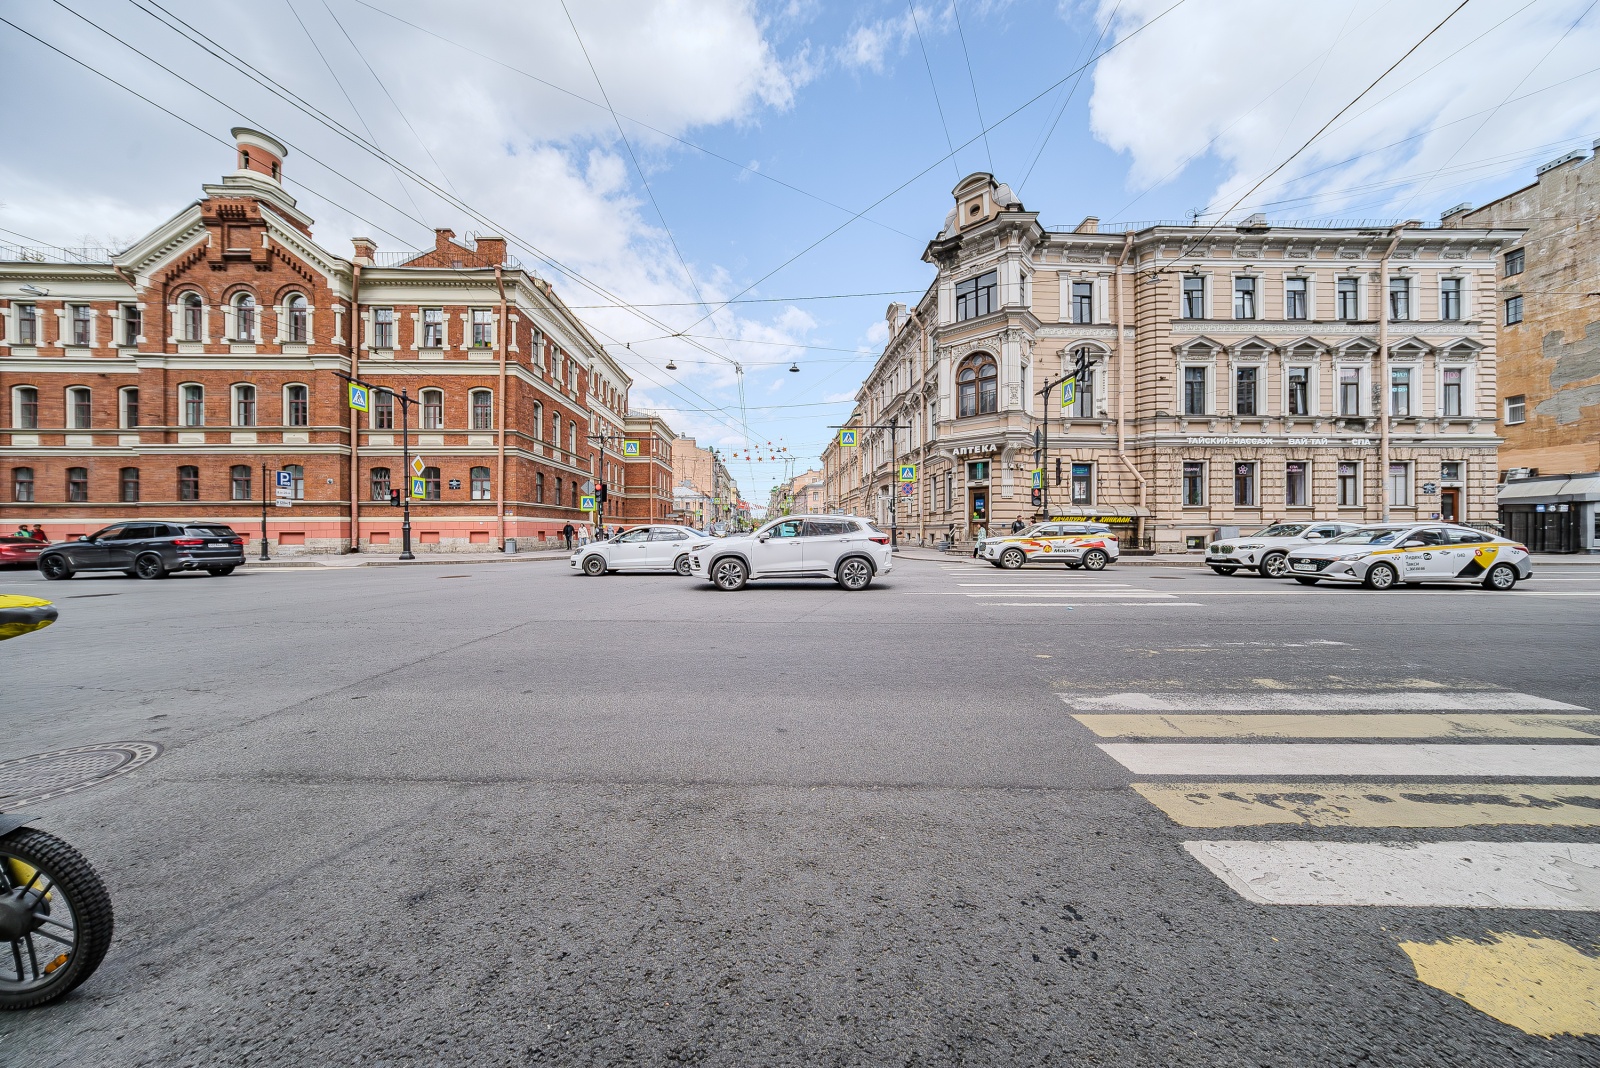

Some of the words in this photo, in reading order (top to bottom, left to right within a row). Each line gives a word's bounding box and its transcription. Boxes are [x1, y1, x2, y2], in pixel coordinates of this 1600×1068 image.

[1233, 437, 1273, 445] МАССАЖ
[952, 444, 997, 455] АПТЕКА
[280, 473, 290, 486] P
